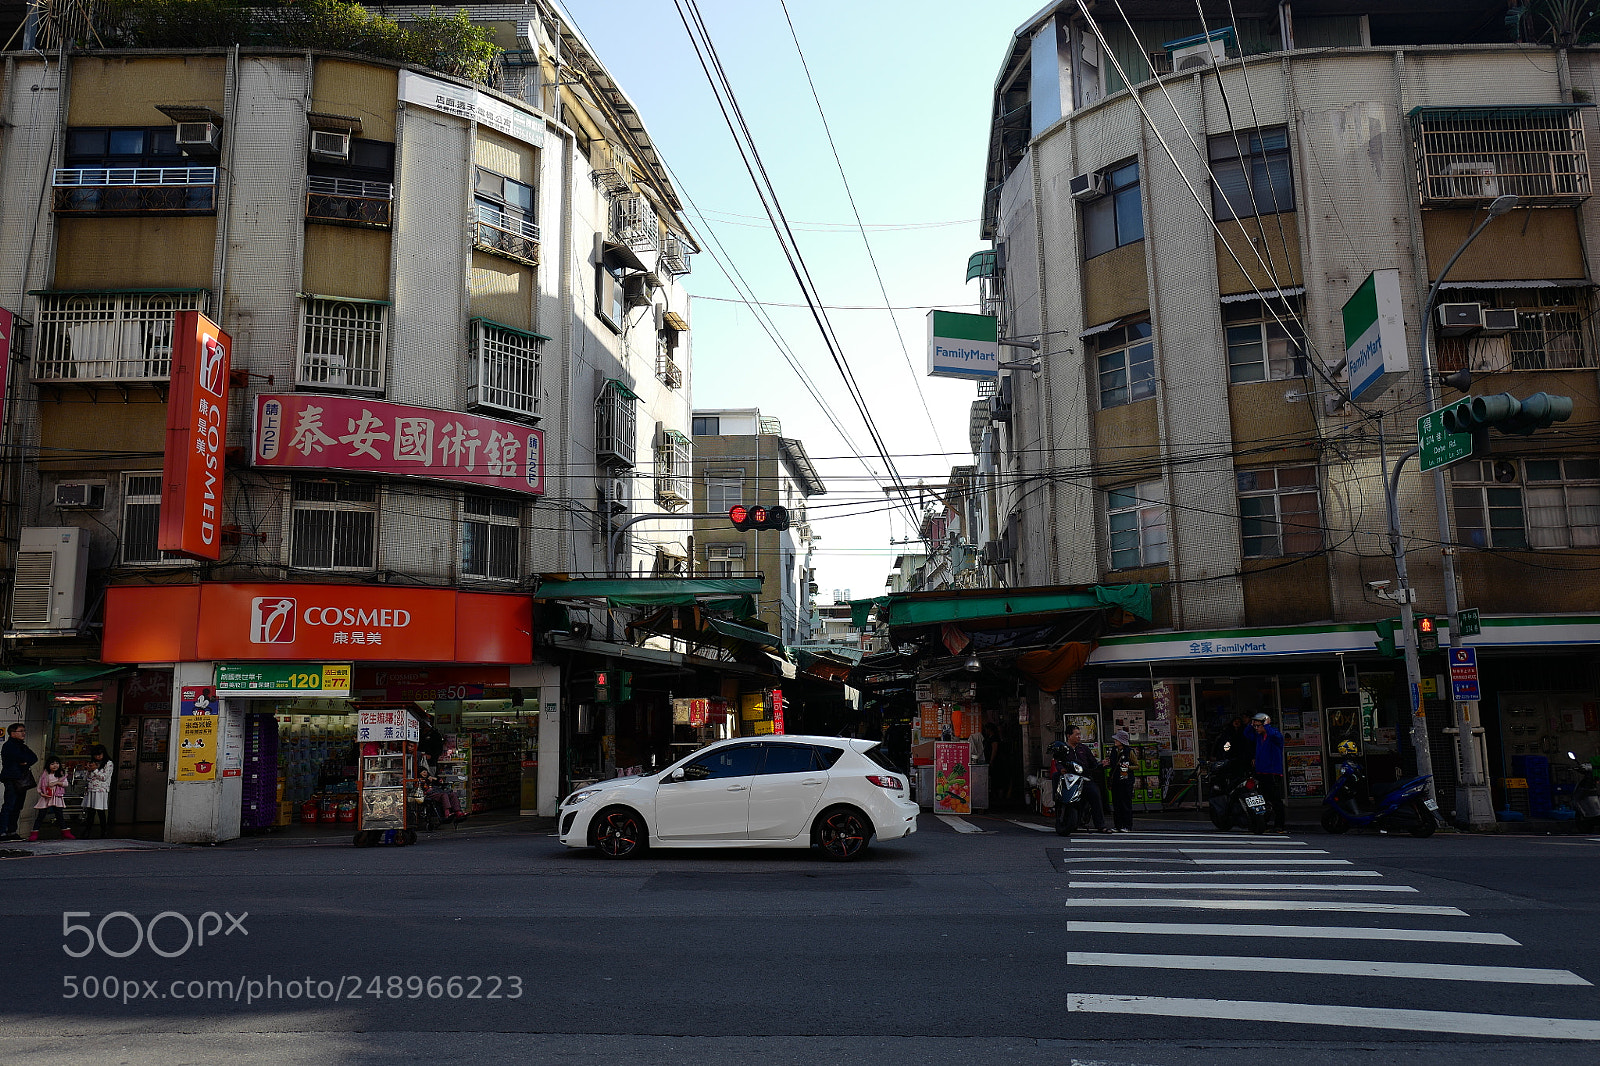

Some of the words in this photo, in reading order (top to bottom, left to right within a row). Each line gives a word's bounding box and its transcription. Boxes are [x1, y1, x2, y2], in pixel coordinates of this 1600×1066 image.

[936, 346, 995, 361] FamilyMart
[1349, 333, 1382, 377] FamilyMart
[195, 398, 210, 457] 康是美
[262, 403, 279, 457] 請上2F
[528, 436, 538, 484] 請上2F
[201, 404, 221, 546] COSMED
[756, 508, 765, 522] 10
[303, 606, 411, 628] COSMED
[332, 630, 382, 645] 康是美
[1189, 641, 1213, 654] 全家
[1216, 642, 1266, 653] FamilyMart
[126, 672, 169, 698] 泰安
[288, 672, 320, 688] 120
[331, 678, 346, 687] 77
[395, 730, 405, 738] 20
